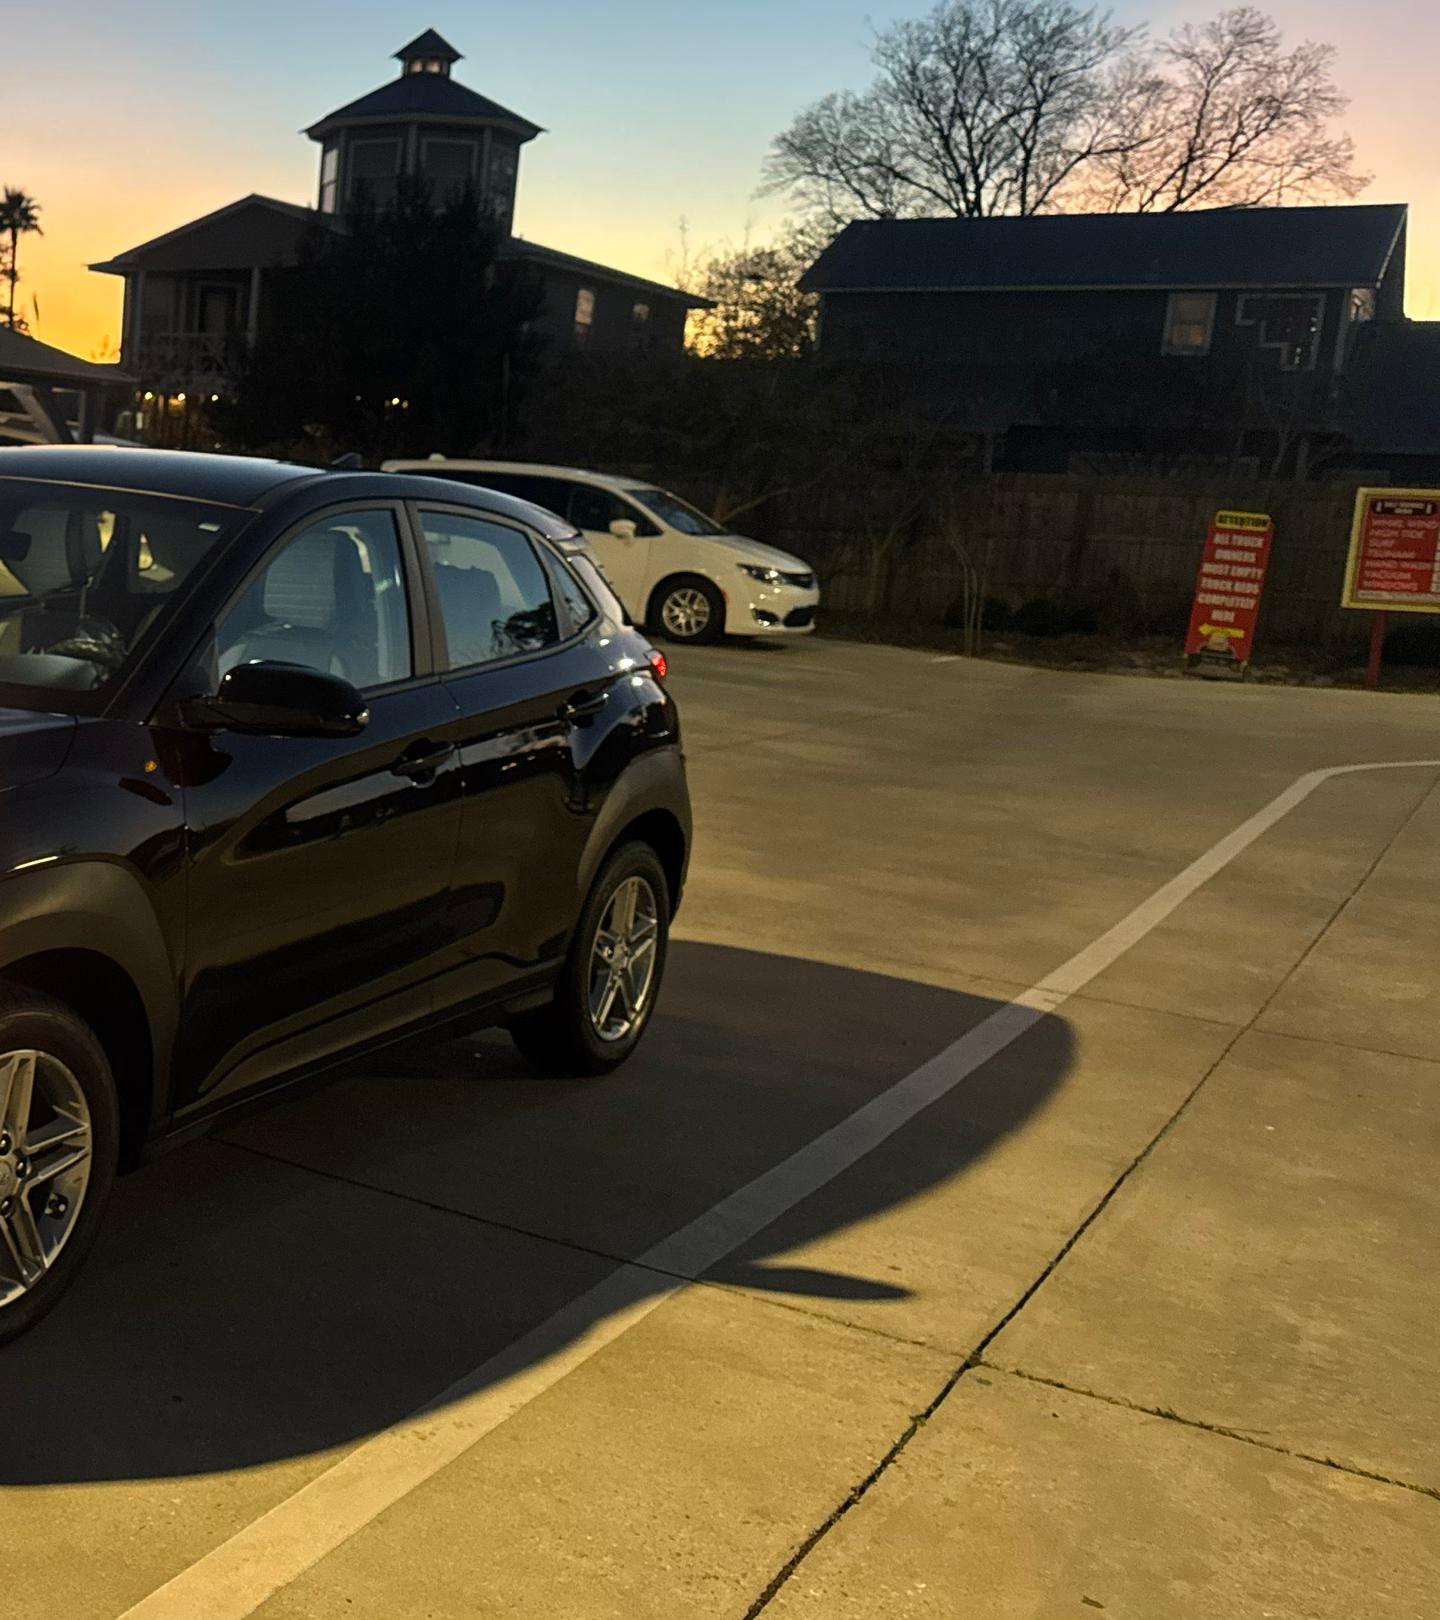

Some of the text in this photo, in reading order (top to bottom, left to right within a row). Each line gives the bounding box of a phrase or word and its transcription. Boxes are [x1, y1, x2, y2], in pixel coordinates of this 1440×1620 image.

[1218, 514, 1268, 527] ATTENTION
[1213, 532, 1265, 548] ALL TRUCK
[1215, 548, 1257, 564] OWNERS
[1202, 563, 1265, 580] MUST EMPTY
